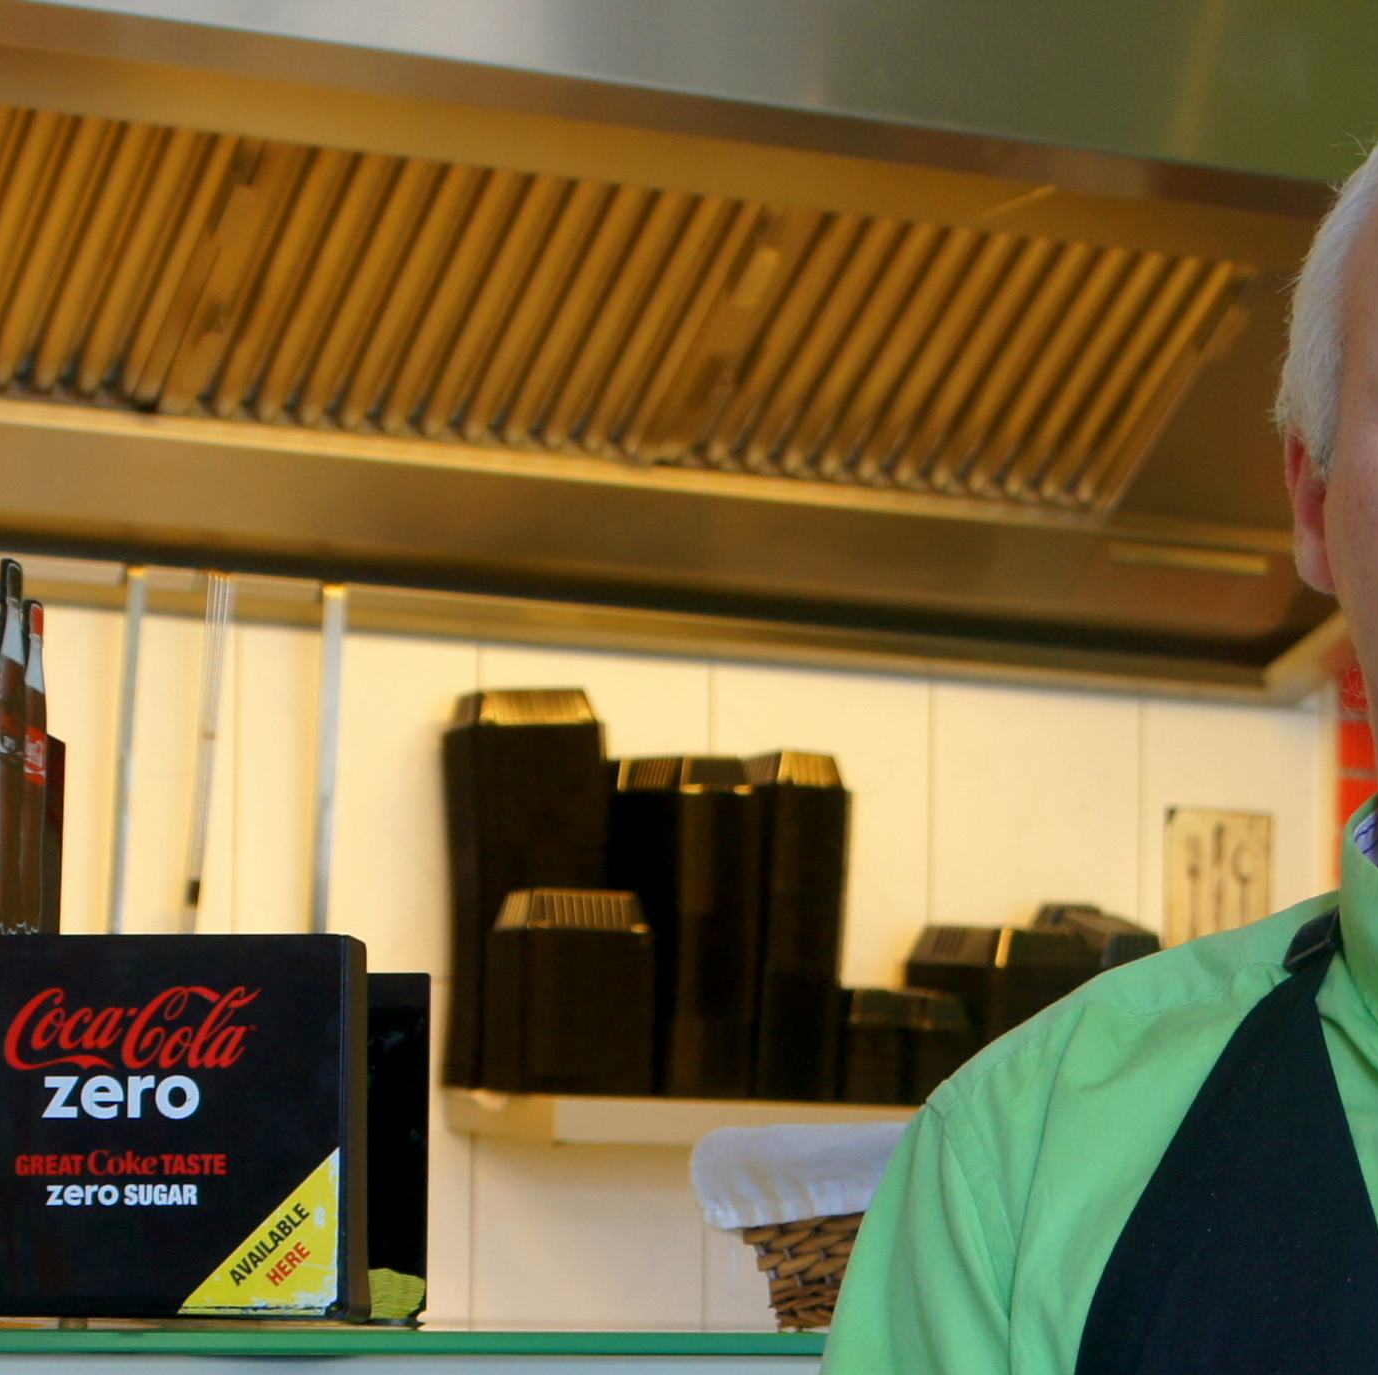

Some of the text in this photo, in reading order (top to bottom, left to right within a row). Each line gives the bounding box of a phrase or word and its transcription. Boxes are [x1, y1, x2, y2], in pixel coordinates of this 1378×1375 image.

[4, 985, 261, 1070] Coca-Cola
[41, 1074, 200, 1120] zero
[15, 1149, 227, 1176] GREAT Coke TASTE
[45, 1184, 198, 1206] zero SUGAR
[229, 1203, 310, 1287] AVAILABLE
[265, 1241, 311, 1287] HERE
